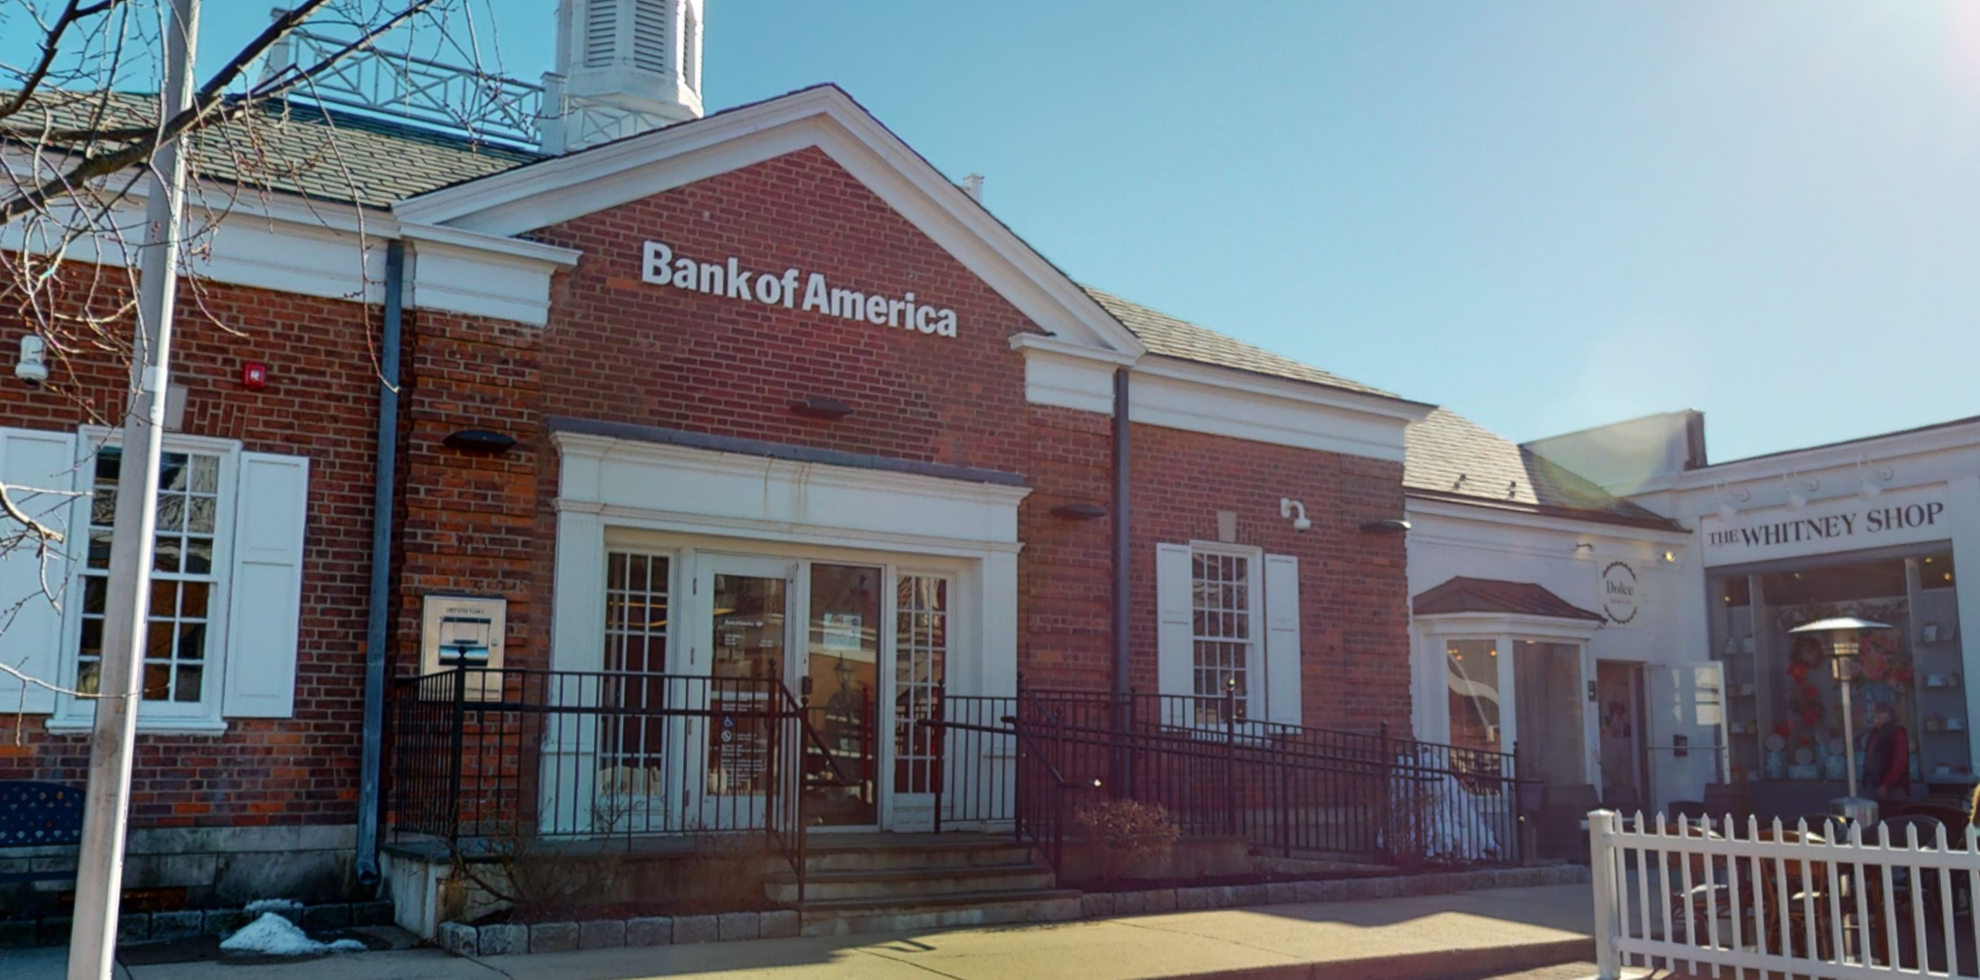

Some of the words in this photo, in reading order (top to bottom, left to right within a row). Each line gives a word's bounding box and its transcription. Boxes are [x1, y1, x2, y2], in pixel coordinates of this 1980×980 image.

[642, 240, 752, 301] Bank
[755, 268, 799, 309] of
[802, 272, 957, 338] America
[1708, 529, 1739, 546] THE
[1741, 512, 1857, 547] WHITNEY
[1866, 502, 1944, 534] SHOP
[1606, 580, 1634, 596] Dolce
